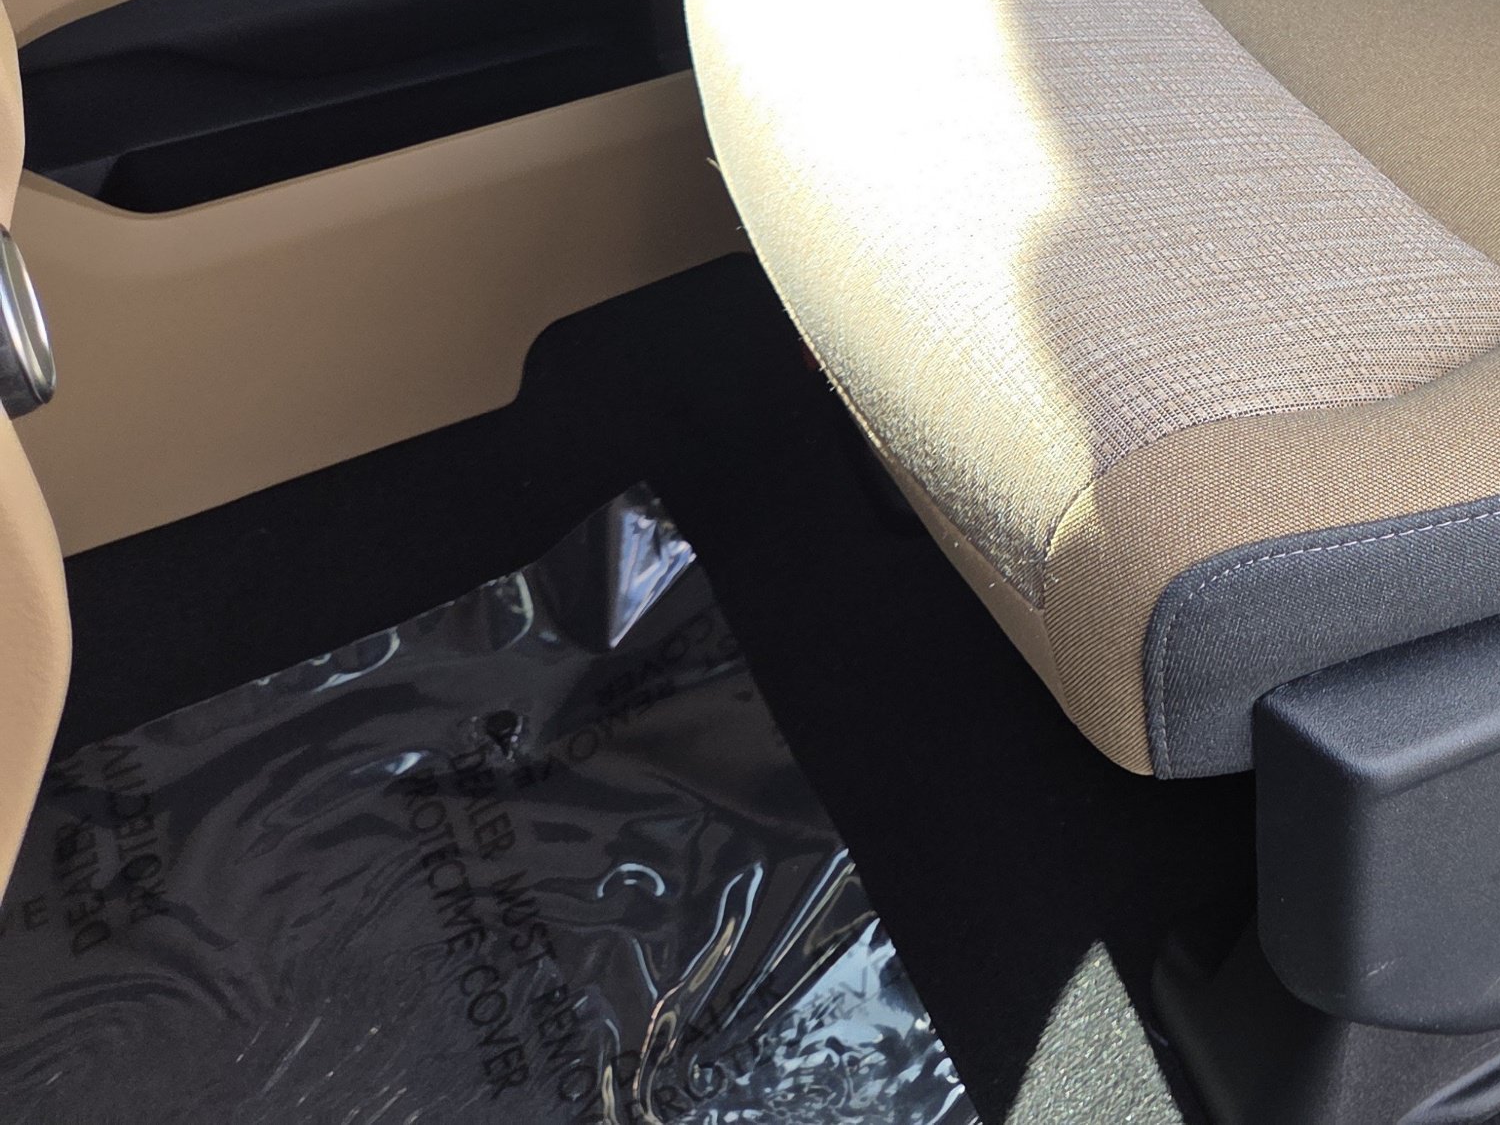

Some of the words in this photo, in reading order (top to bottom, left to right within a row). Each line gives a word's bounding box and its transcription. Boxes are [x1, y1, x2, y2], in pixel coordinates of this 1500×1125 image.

[55, 815, 111, 956] DEALER
[97, 743, 167, 924] PROTECTIV
[399, 770, 488, 958] PROTECTIVE
[458, 963, 531, 1101] COVER
[449, 743, 517, 862] DEALER
[493, 868, 558, 970] MUST
